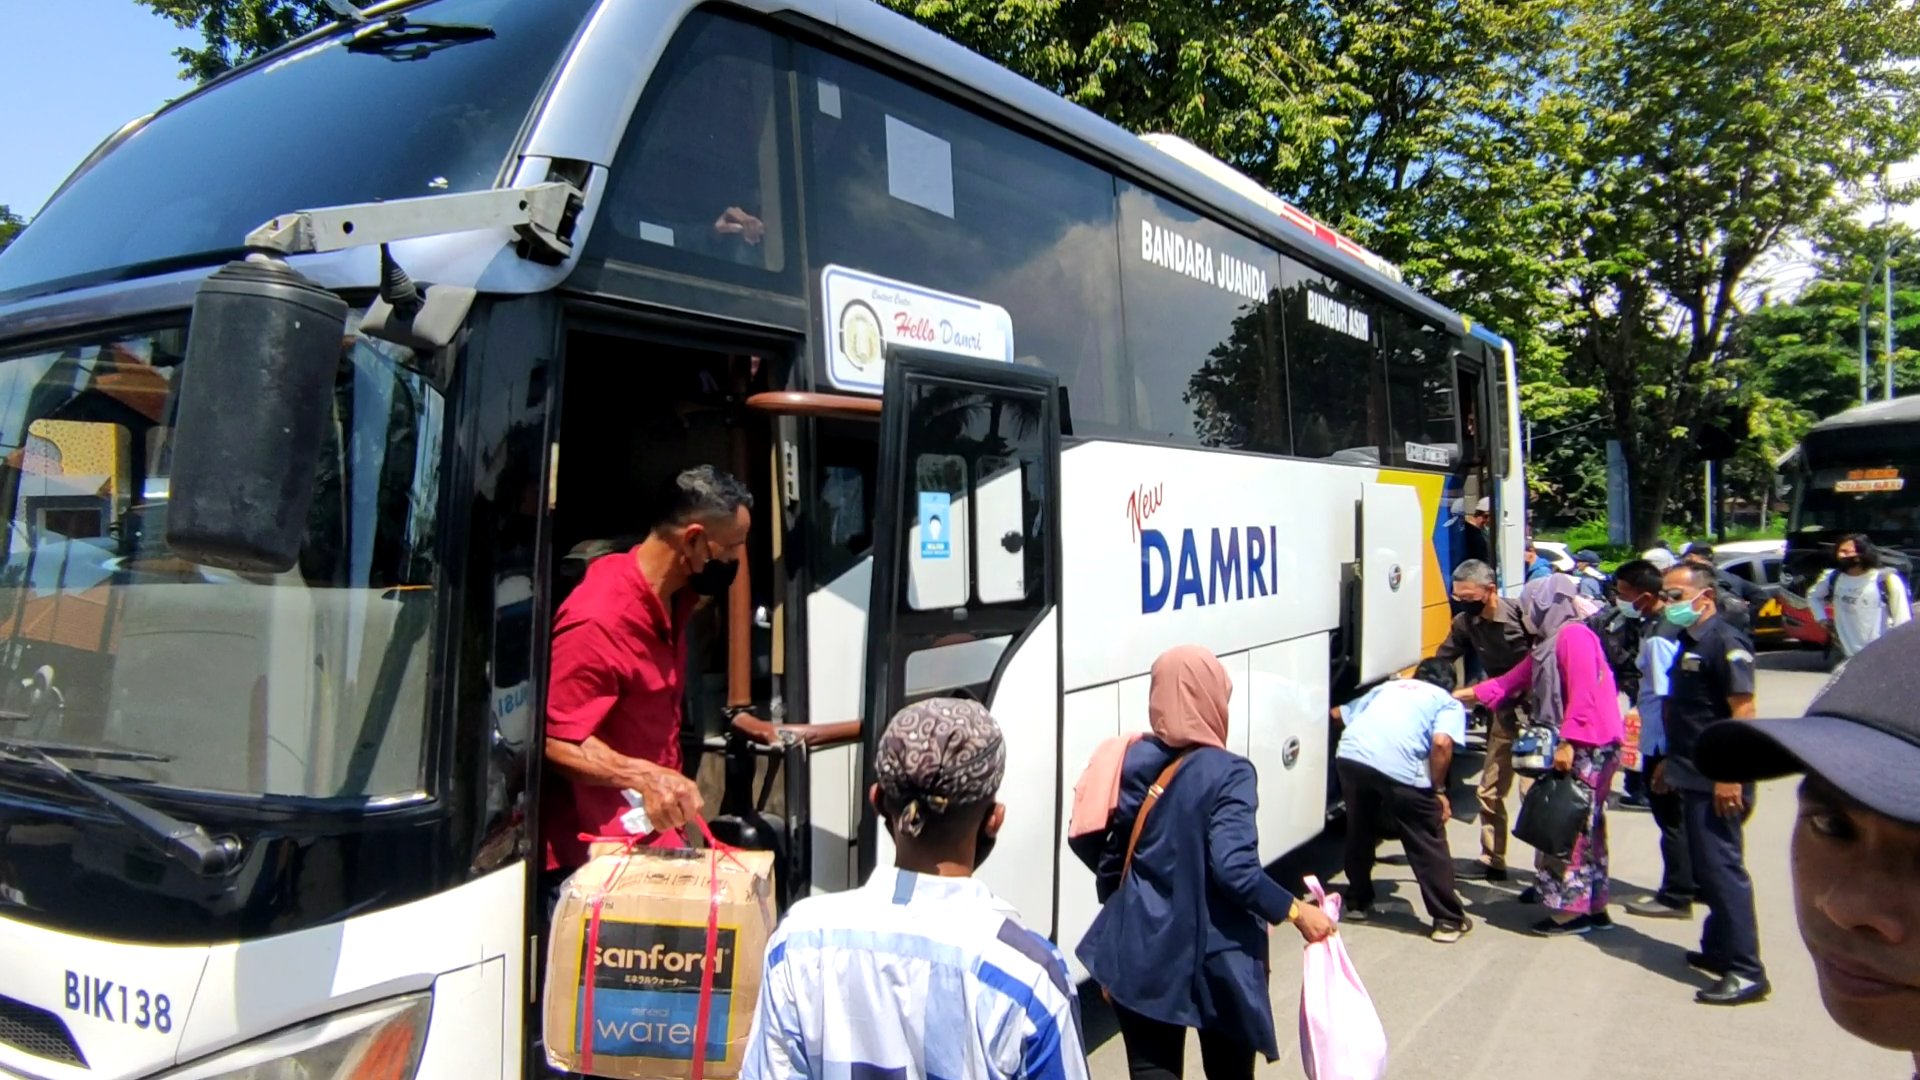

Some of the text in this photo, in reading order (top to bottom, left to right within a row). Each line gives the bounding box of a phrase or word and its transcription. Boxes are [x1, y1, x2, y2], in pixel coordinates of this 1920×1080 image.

[1141, 219, 1269, 304] BANDARA JUANDA
[894, 312, 982, 351] Hello Damri
[1307, 289, 1369, 342] BUNGUR ASIH
[1127, 482, 1163, 543] New
[1141, 525, 1278, 615] DAMRI
[65, 969, 172, 1034] BIK138
